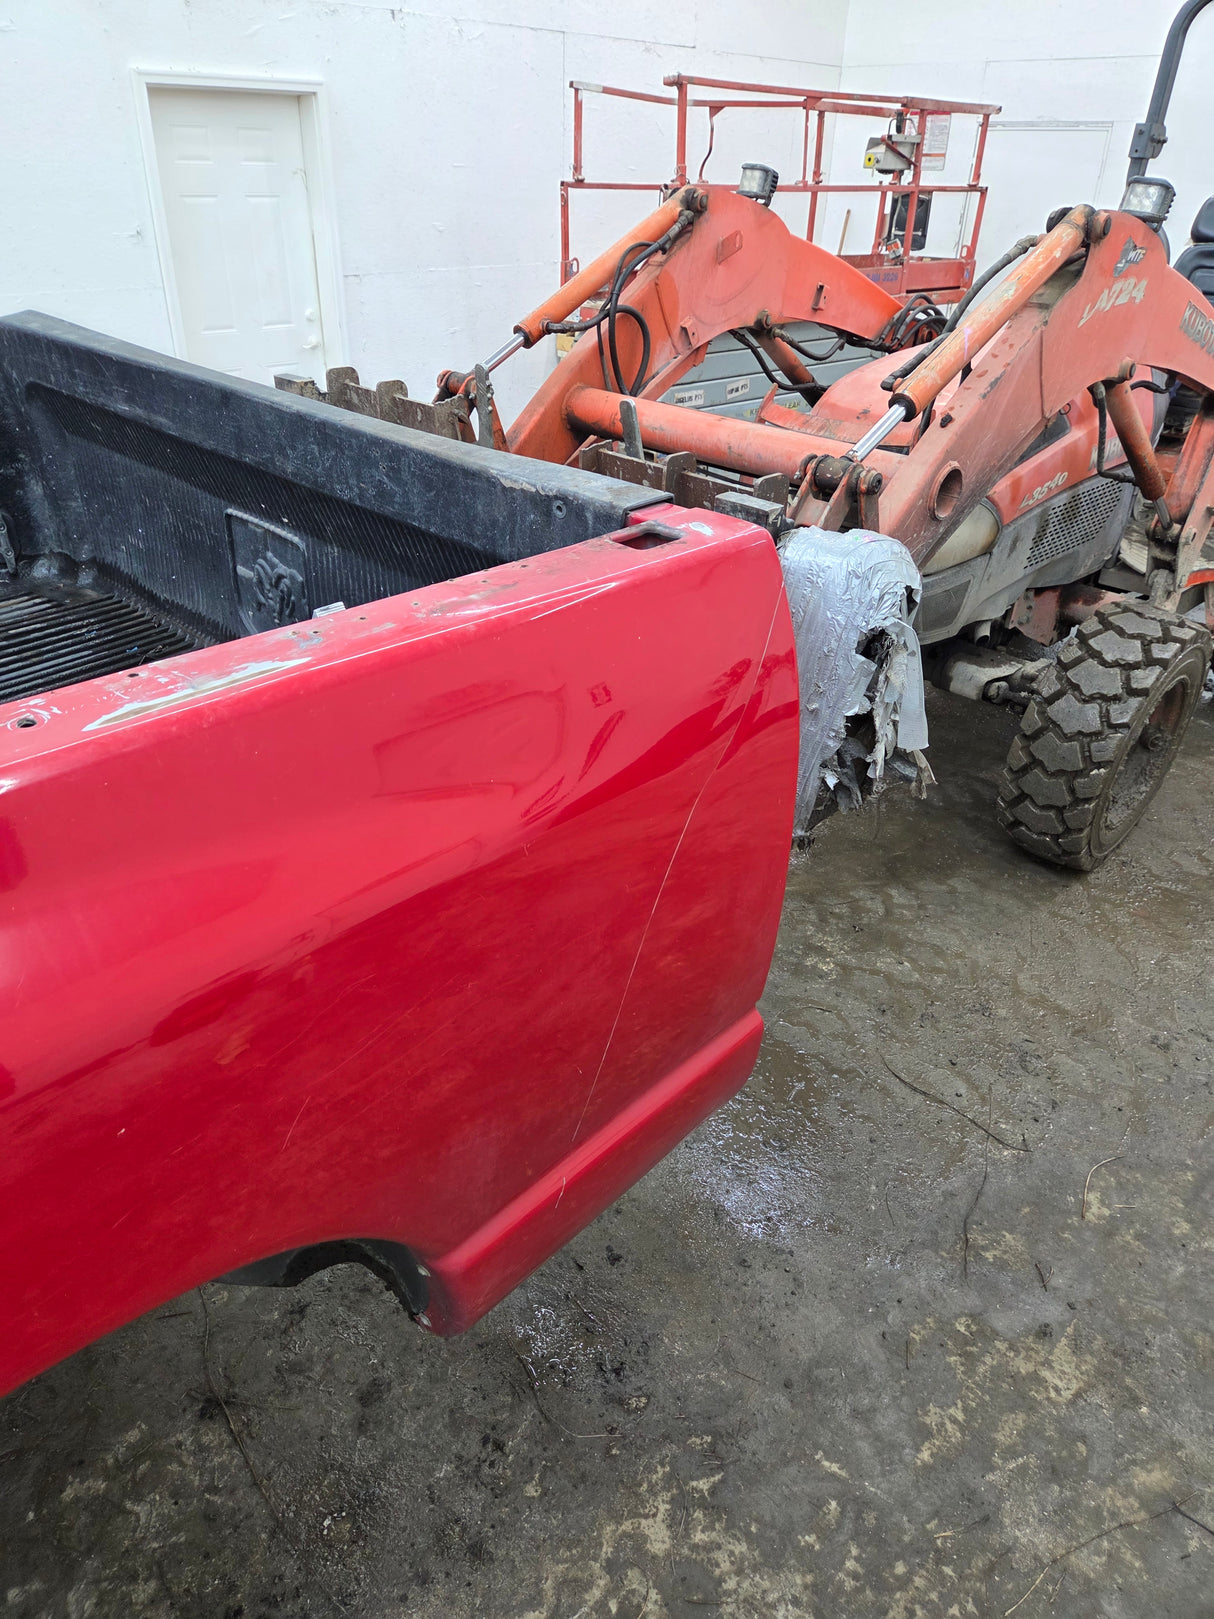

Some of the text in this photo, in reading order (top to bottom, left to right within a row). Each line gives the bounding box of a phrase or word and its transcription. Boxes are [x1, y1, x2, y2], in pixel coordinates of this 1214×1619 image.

[1078, 277, 1149, 328] LA724
[1180, 300, 1214, 358] KUBOT
[1019, 472, 1069, 509] L3540
